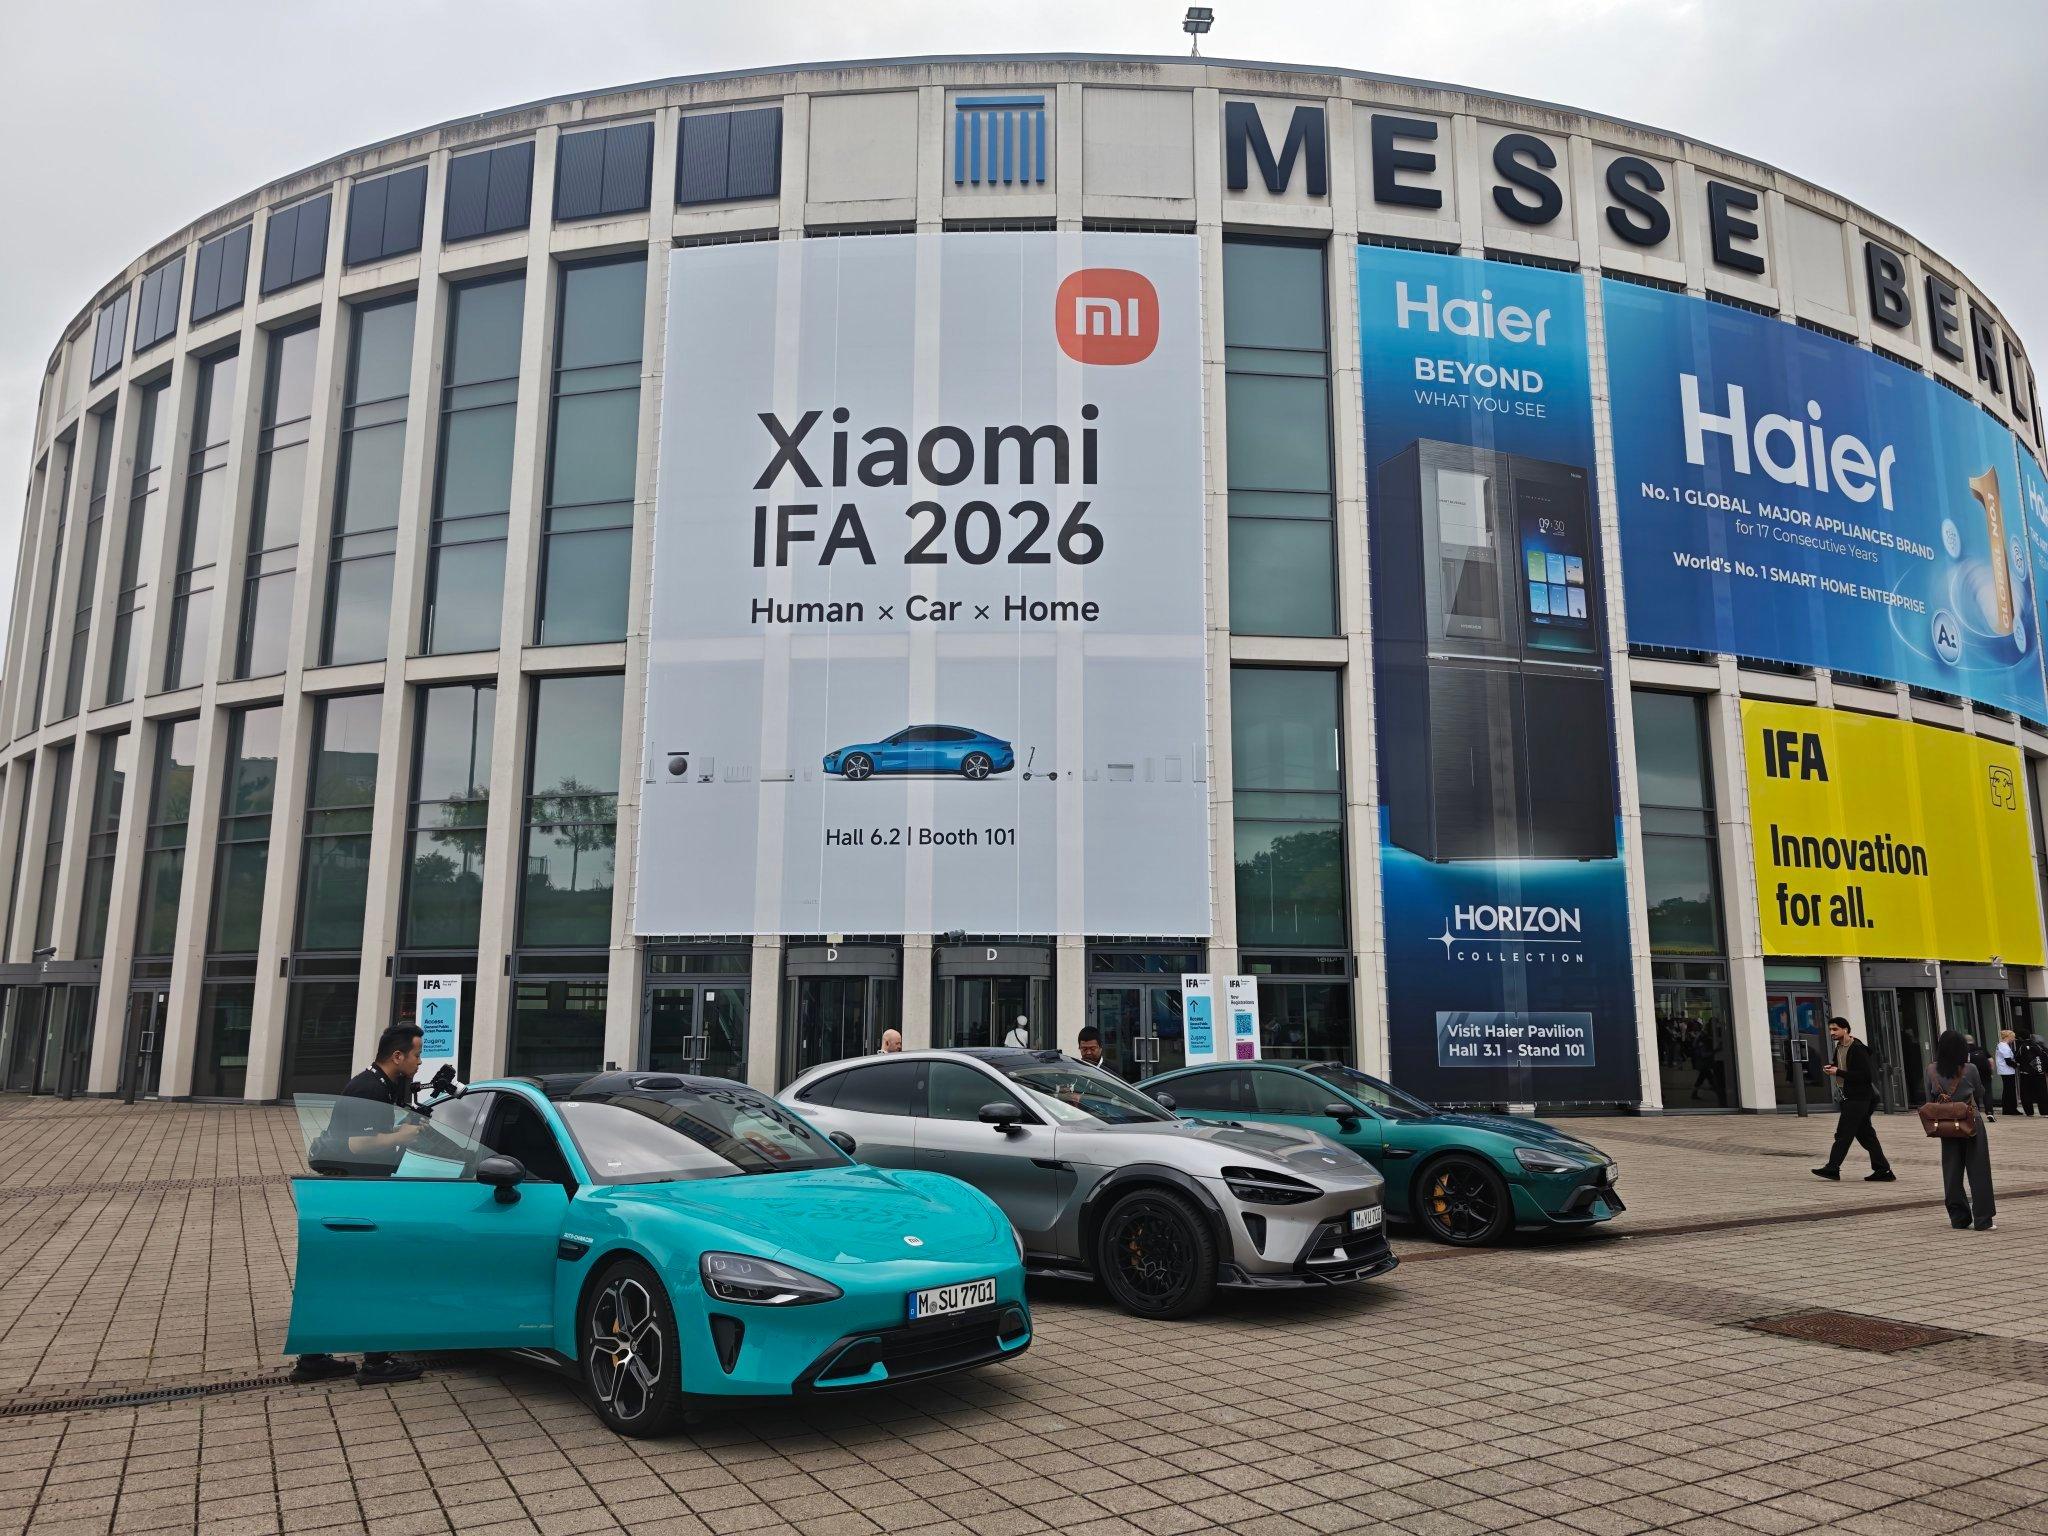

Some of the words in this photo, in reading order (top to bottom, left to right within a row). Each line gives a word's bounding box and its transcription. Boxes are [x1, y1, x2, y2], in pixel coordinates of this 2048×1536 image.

[1225, 101, 1766, 275] MESSE
[1396, 281, 1551, 346] Haier
[1414, 357, 1544, 394] BEYOND
[1414, 389, 1468, 409] WHAT
[1473, 396, 1510, 414] YOU
[1515, 401, 1547, 419] SEE
[752, 403, 1100, 490] Xiaomi
[1680, 373, 1896, 512] Haier
[753, 502, 877, 567] IFA
[904, 500, 1105, 566] 2026
[1641, 482, 1670, 501] No.
[1673, 487, 1681, 502] 1
[1685, 489, 1752, 515] GLOBAL
[1758, 502, 1812, 527] MAJOR
[1815, 515, 1895, 548] APPLIANCES
[1897, 537, 1935, 561] BRAND
[1735, 519, 1755, 535] for
[1756, 523, 1769, 538] 17
[1773, 527, 1847, 556] Consecutive
[1848, 544, 1879, 563] Years
[1673, 551, 1731, 573] World's
[1735, 560, 1759, 579] No.
[1761, 565, 1767, 580] 1
[1770, 568, 1817, 589] SMART
[1820, 576, 1858, 598] HOME
[1860, 586, 1926, 615] ENTERPRISE
[751, 597, 864, 624] Human
[905, 595, 963, 622] Car
[1004, 595, 1100, 622] Home
[1763, 728, 1829, 782] IFA
[826, 828, 863, 846] Hall
[870, 829, 901, 845] 6.2
[919, 828, 978, 845] Booth
[985, 828, 1016, 845] 101
[1770, 823, 1929, 877] Innovation
[1454, 905, 1582, 933] HORIZON
[1776, 882, 1822, 927] for
[1830, 885, 1875, 929] all.
[827, 949, 838, 961] D
[986, 949, 998, 961] D
[1457, 952, 1584, 963] COLLECTION
[423, 980, 440, 989] IFA
[1186, 979, 1198, 988] IFA
[1229, 980, 1241, 988] IFA
[1447, 1024, 1482, 1038] Visit
[1485, 1024, 1524, 1038] Haier
[1528, 1024, 1584, 1038] Pavilion
[1449, 1043, 1478, 1057] Hall
[1483, 1044, 1501, 1057] 3.1
[1518, 1043, 1560, 1057] Stand
[1565, 1043, 1586, 1057] 101
[918, 1293, 929, 1315] M
[938, 1289, 958, 1310] SU
[960, 1281, 994, 1307] 7701
